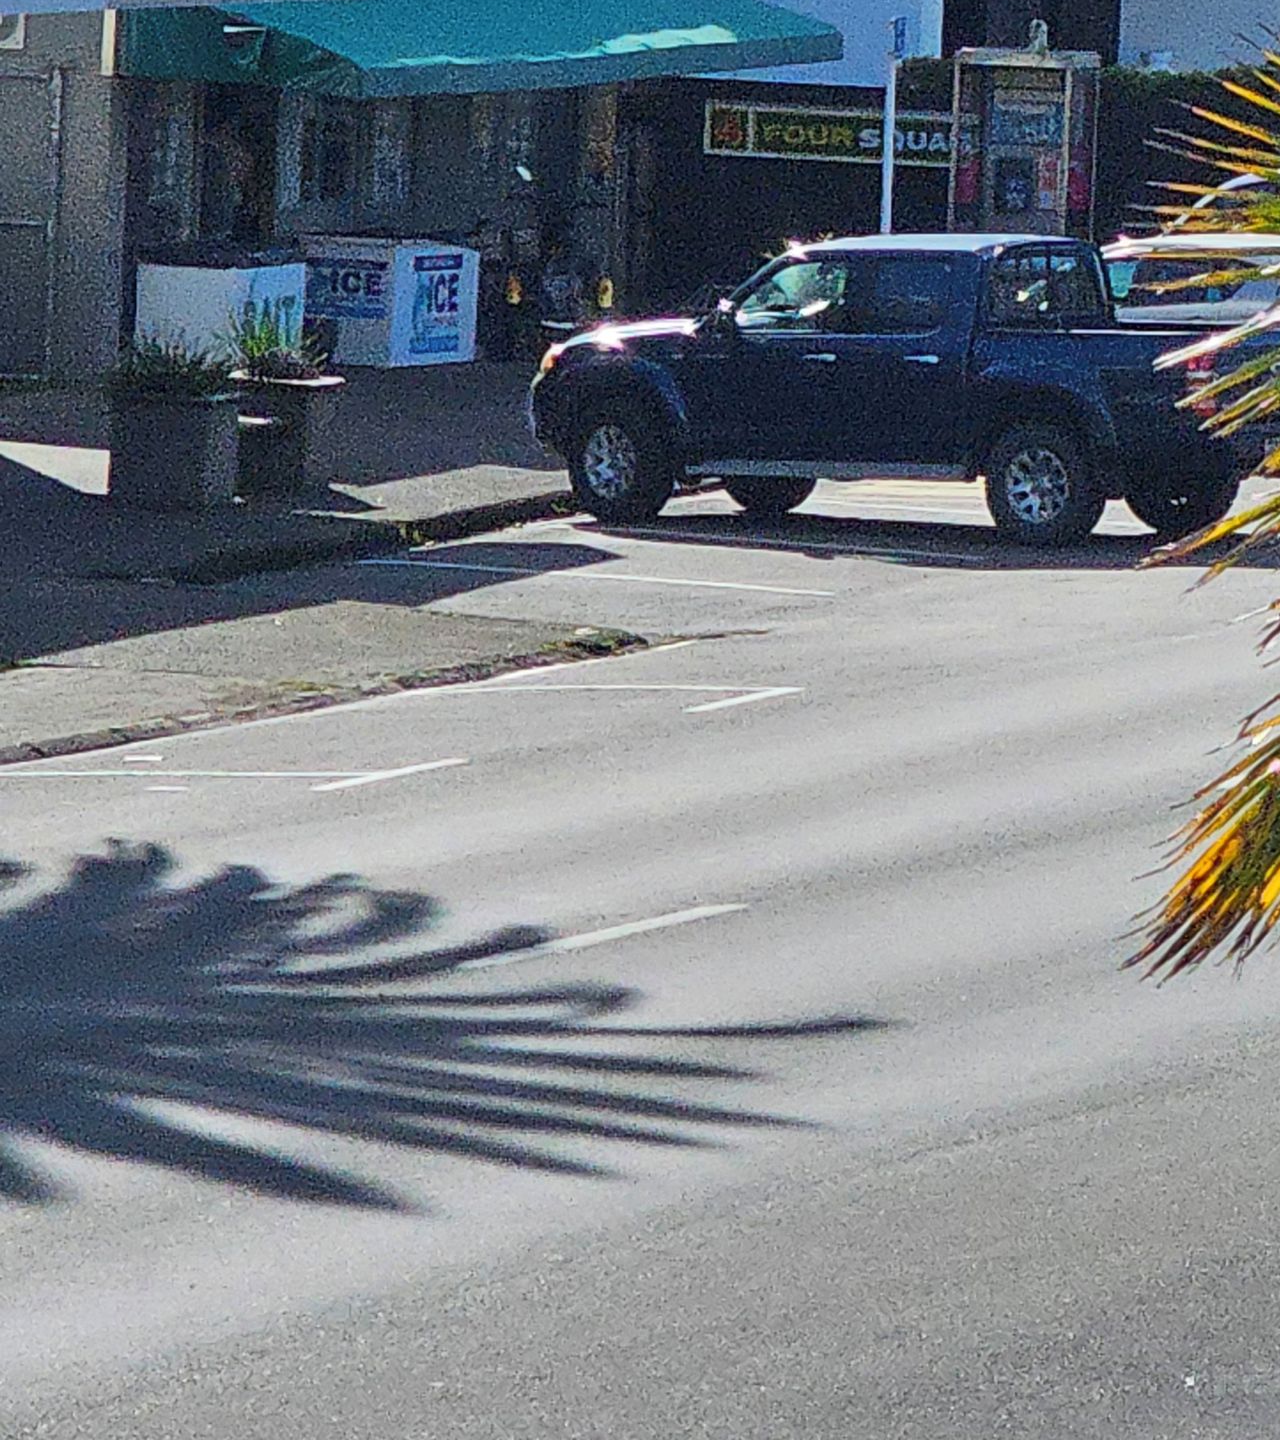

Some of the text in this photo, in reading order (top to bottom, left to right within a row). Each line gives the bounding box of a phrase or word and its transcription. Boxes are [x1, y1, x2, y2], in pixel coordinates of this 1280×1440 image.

[763, 124, 852, 146] FOUR
[330, 269, 383, 297] ICE
[427, 273, 460, 314] ICE
